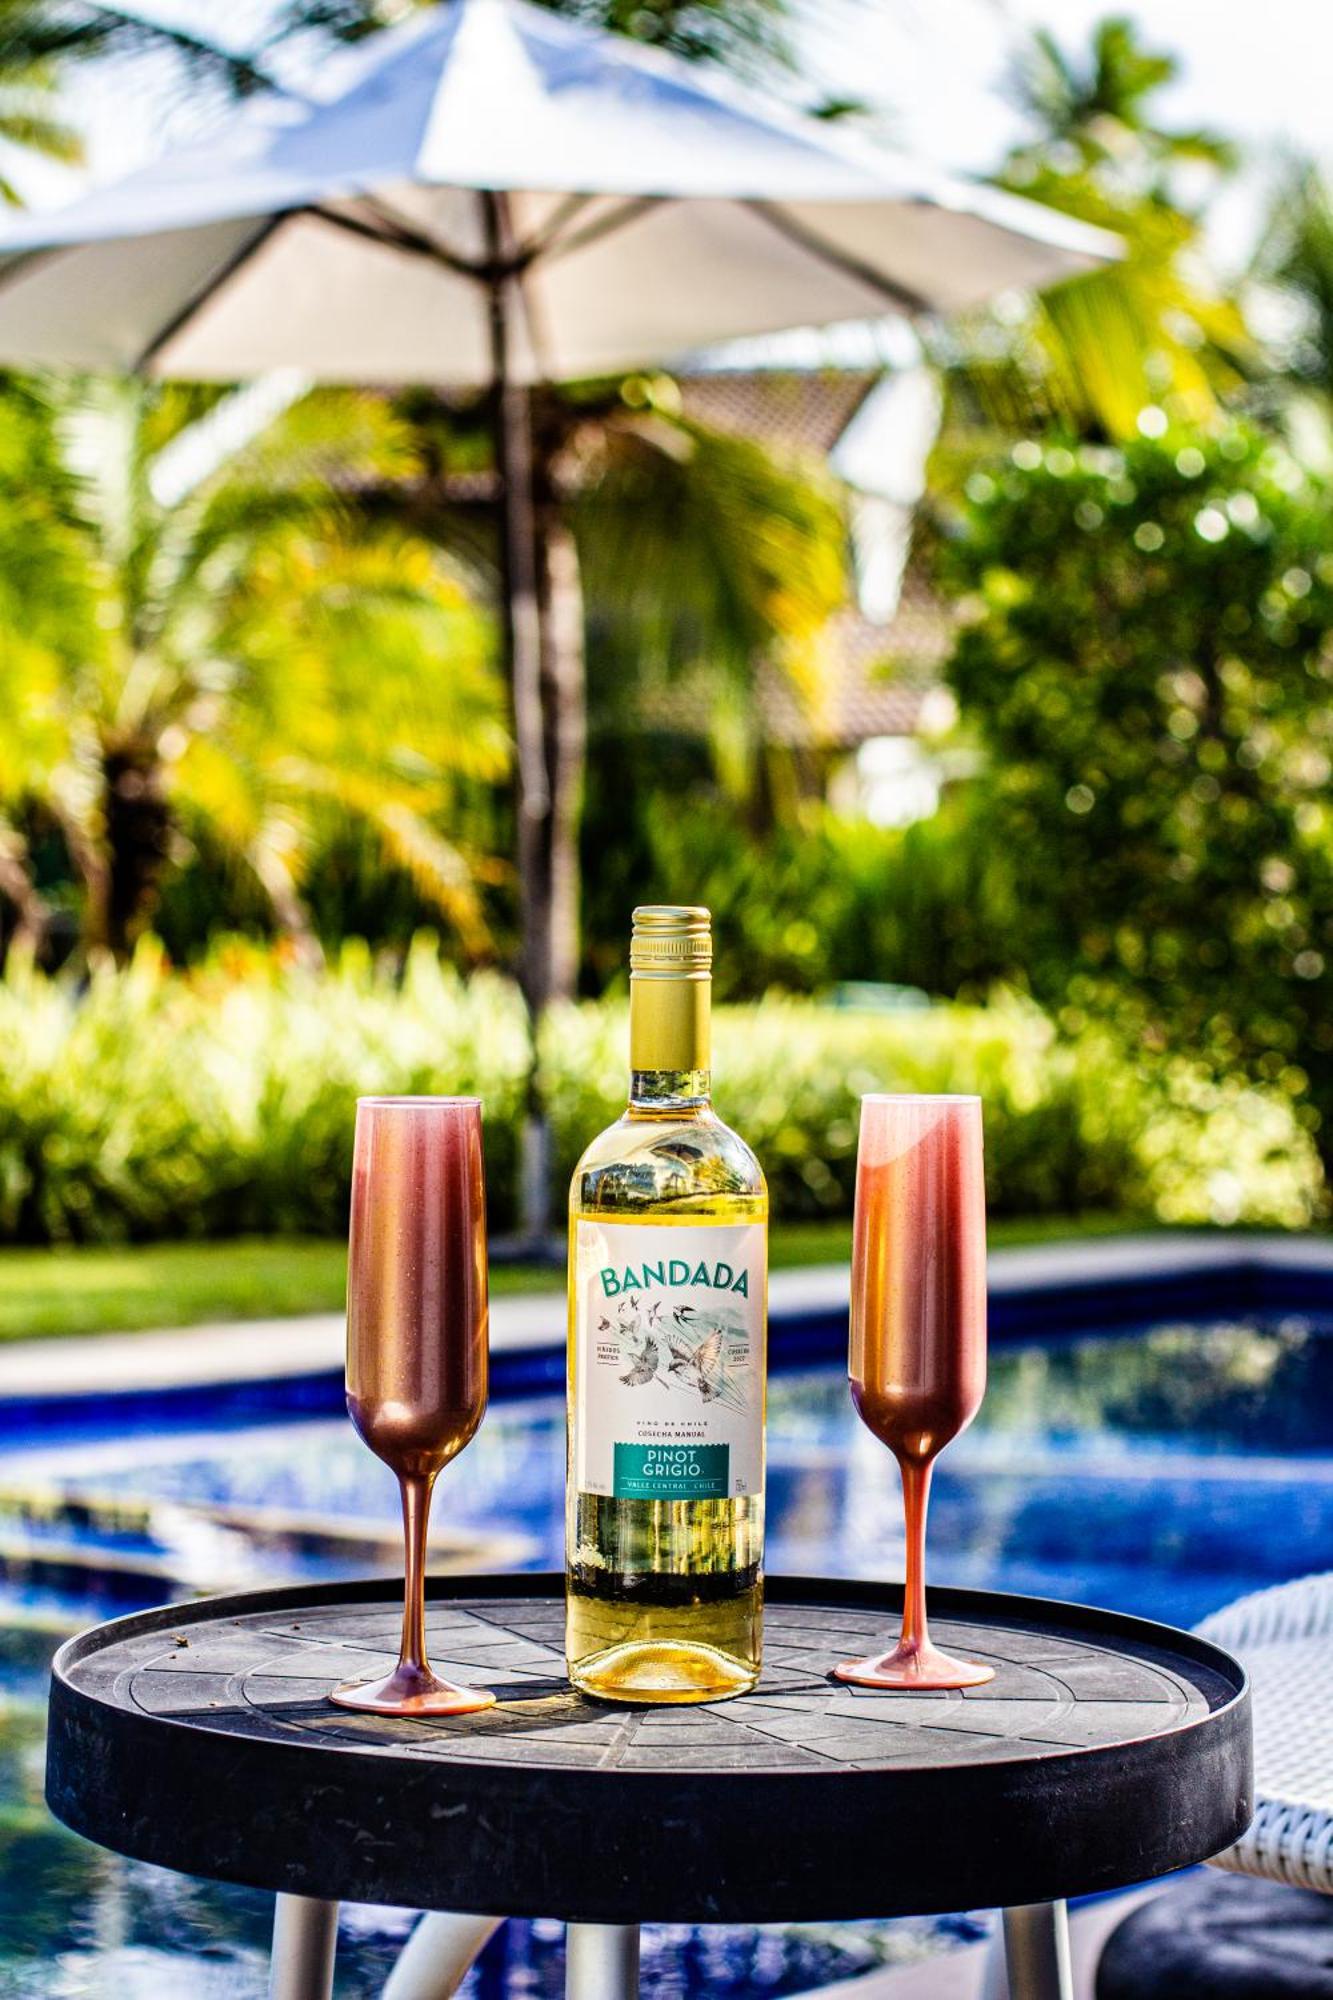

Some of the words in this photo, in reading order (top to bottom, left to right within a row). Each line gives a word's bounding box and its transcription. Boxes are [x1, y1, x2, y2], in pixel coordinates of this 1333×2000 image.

[600, 1260, 749, 1299] BANDADA
[637, 1430, 672, 1438] COSECHA
[674, 1430, 705, 1438] MANUAL
[647, 1450, 696, 1463] PINOT
[642, 1463, 701, 1476] GRIGIO
[627, 1481, 650, 1489] VALLE
